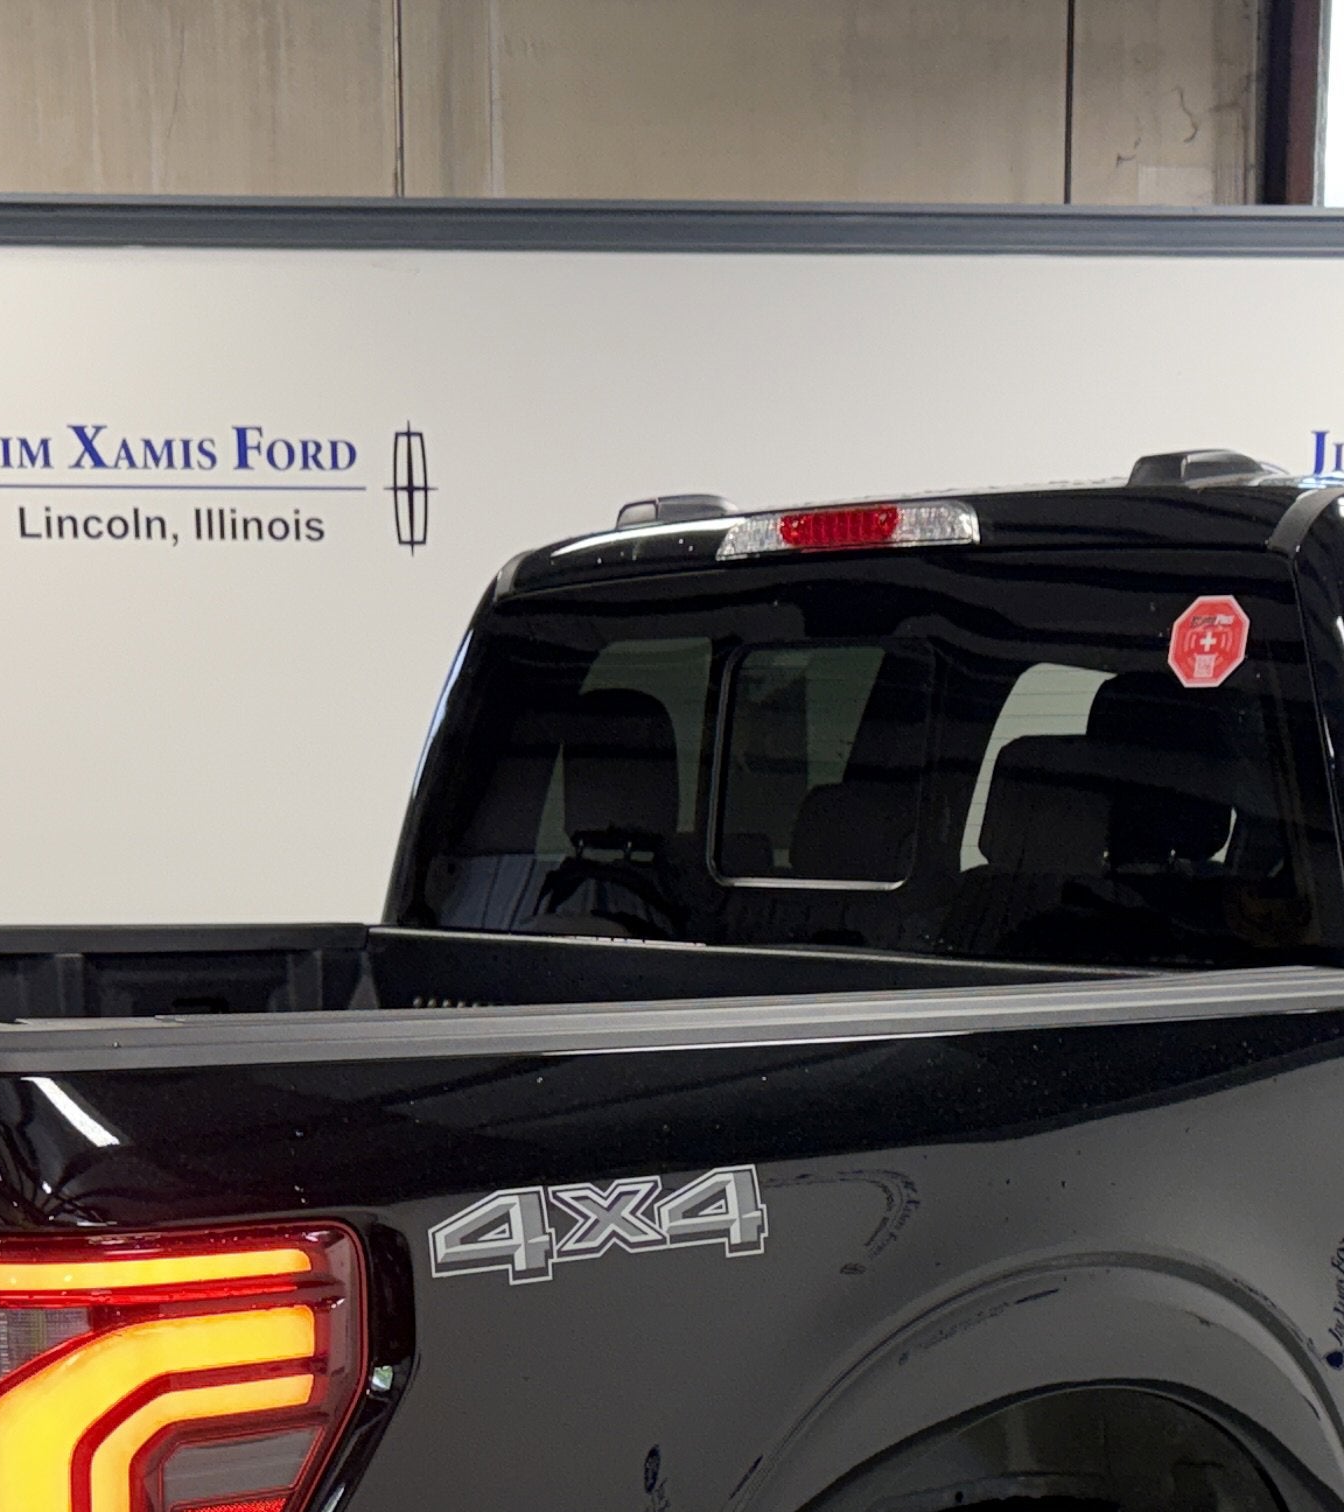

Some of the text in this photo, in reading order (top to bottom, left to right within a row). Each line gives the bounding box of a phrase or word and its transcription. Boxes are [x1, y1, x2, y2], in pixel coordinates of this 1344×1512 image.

[66, 424, 218, 471] XAMIS
[231, 425, 358, 471] FORD
[18, 506, 326, 547] Lincoln, Illinois
